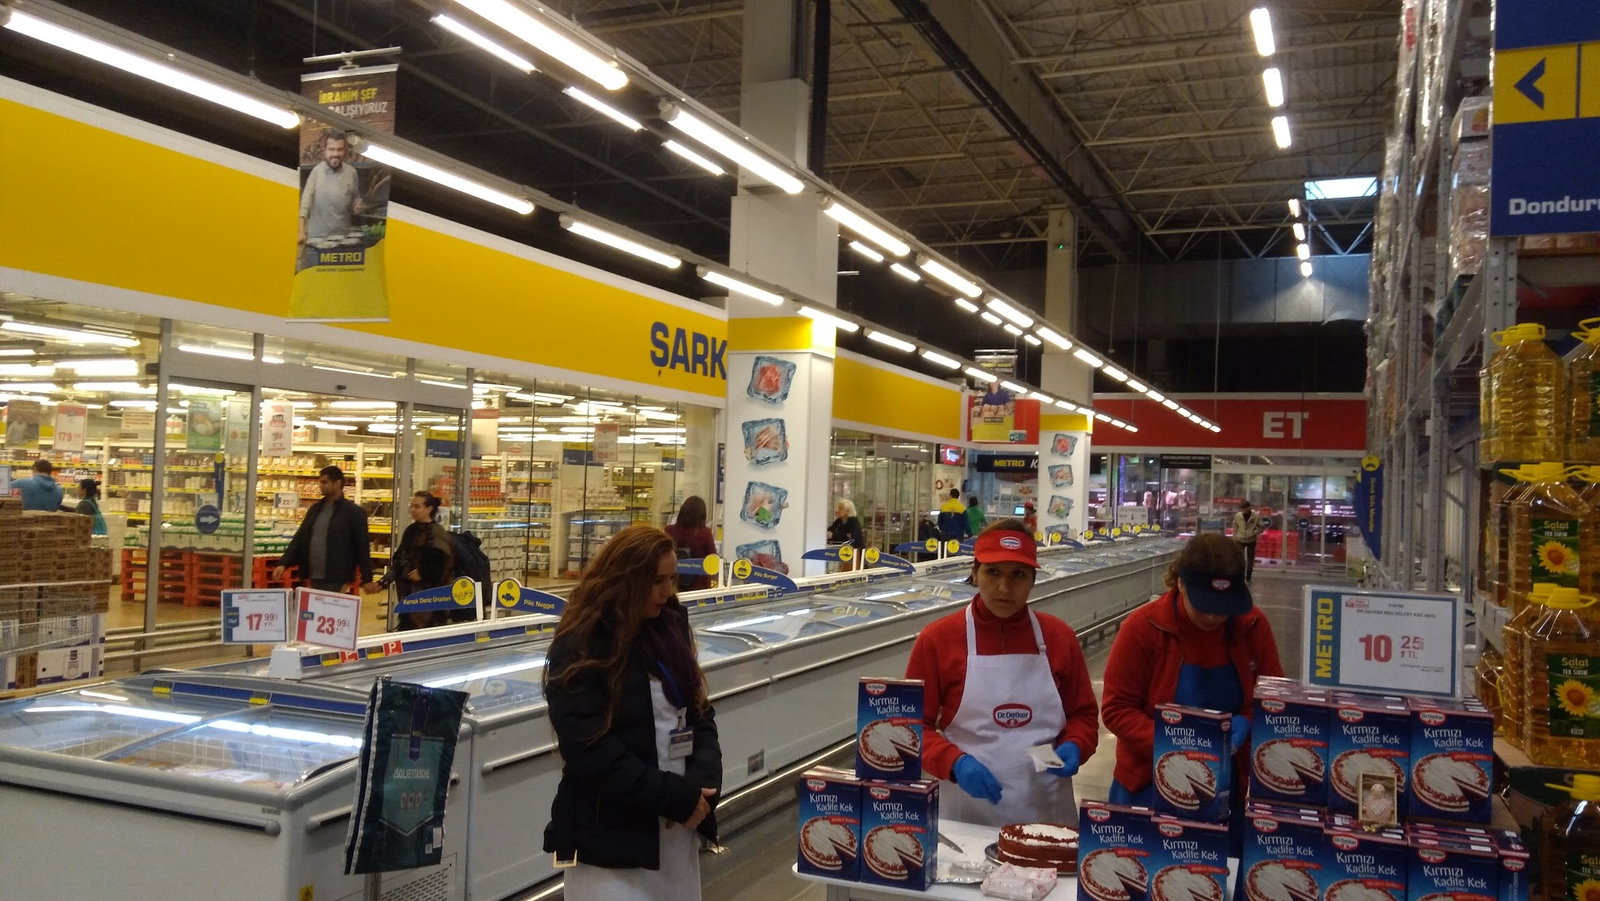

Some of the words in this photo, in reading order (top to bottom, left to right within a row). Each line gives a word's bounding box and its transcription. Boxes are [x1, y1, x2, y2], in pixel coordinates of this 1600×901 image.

[361, 88, 377, 103] ŞEF
[1509, 195, 1600, 215] Dondur
[320, 252, 362, 262] METRO
[1263, 412, 1309, 438] ET
[535, 600, 556, 609] Nugget
[246, 613, 262, 630] 17
[264, 613, 274, 621] 99
[316, 615, 334, 635] 23
[336, 619, 346, 628] 99
[1315, 598, 1333, 678] METRO
[1359, 634, 1392, 662] 10
[1401, 636, 1420, 649] 25
[869, 697, 899, 707] Kırmızı
[876, 704, 900, 715] Kadife
[902, 704, 916, 713] Kek
[1265, 715, 1300, 725] Kırmızı
[1165, 726, 1195, 737] Kırmızı
[1274, 724, 1300, 734] Kadife
[1303, 725, 1320, 735] Kek
[1343, 725, 1379, 735] Kırmızı
[1424, 727, 1462, 738] Kırmızı
[1172, 736, 1196, 746] Kadife
[1197, 737, 1212, 748] Kek
[1352, 734, 1380, 745] Kadife
[1383, 734, 1400, 745] Kek
[1434, 737, 1463, 748] Kadife
[1465, 737, 1484, 748] Kek
[809, 793, 837, 803] Kırmızı
[816, 802, 839, 812] Kadife
[840, 803, 853, 813] Kek
[873, 801, 903, 811] Kırmızı
[881, 811, 904, 820] Kadife
[905, 811, 919, 821] Kek
[1091, 824, 1125, 834] Kırmızı
[1100, 832, 1126, 844] Kadife
[1127, 834, 1144, 845] Kek
[1257, 834, 1293, 845] Kırmızı
[1163, 839, 1198, 850] Kırmızı
[1172, 849, 1199, 860] Kadife
[1201, 850, 1218, 861] Kek
[1266, 844, 1294, 855] Kadife
[1297, 845, 1314, 857] Kek
[1336, 852, 1375, 864] Kırmızı
[1346, 863, 1376, 874] Kadife
[1378, 864, 1396, 876] Kek
[1423, 865, 1463, 878] Kırmızı
[1433, 876, 1464, 888] Kadife
[1468, 877, 1487, 889] Kek
